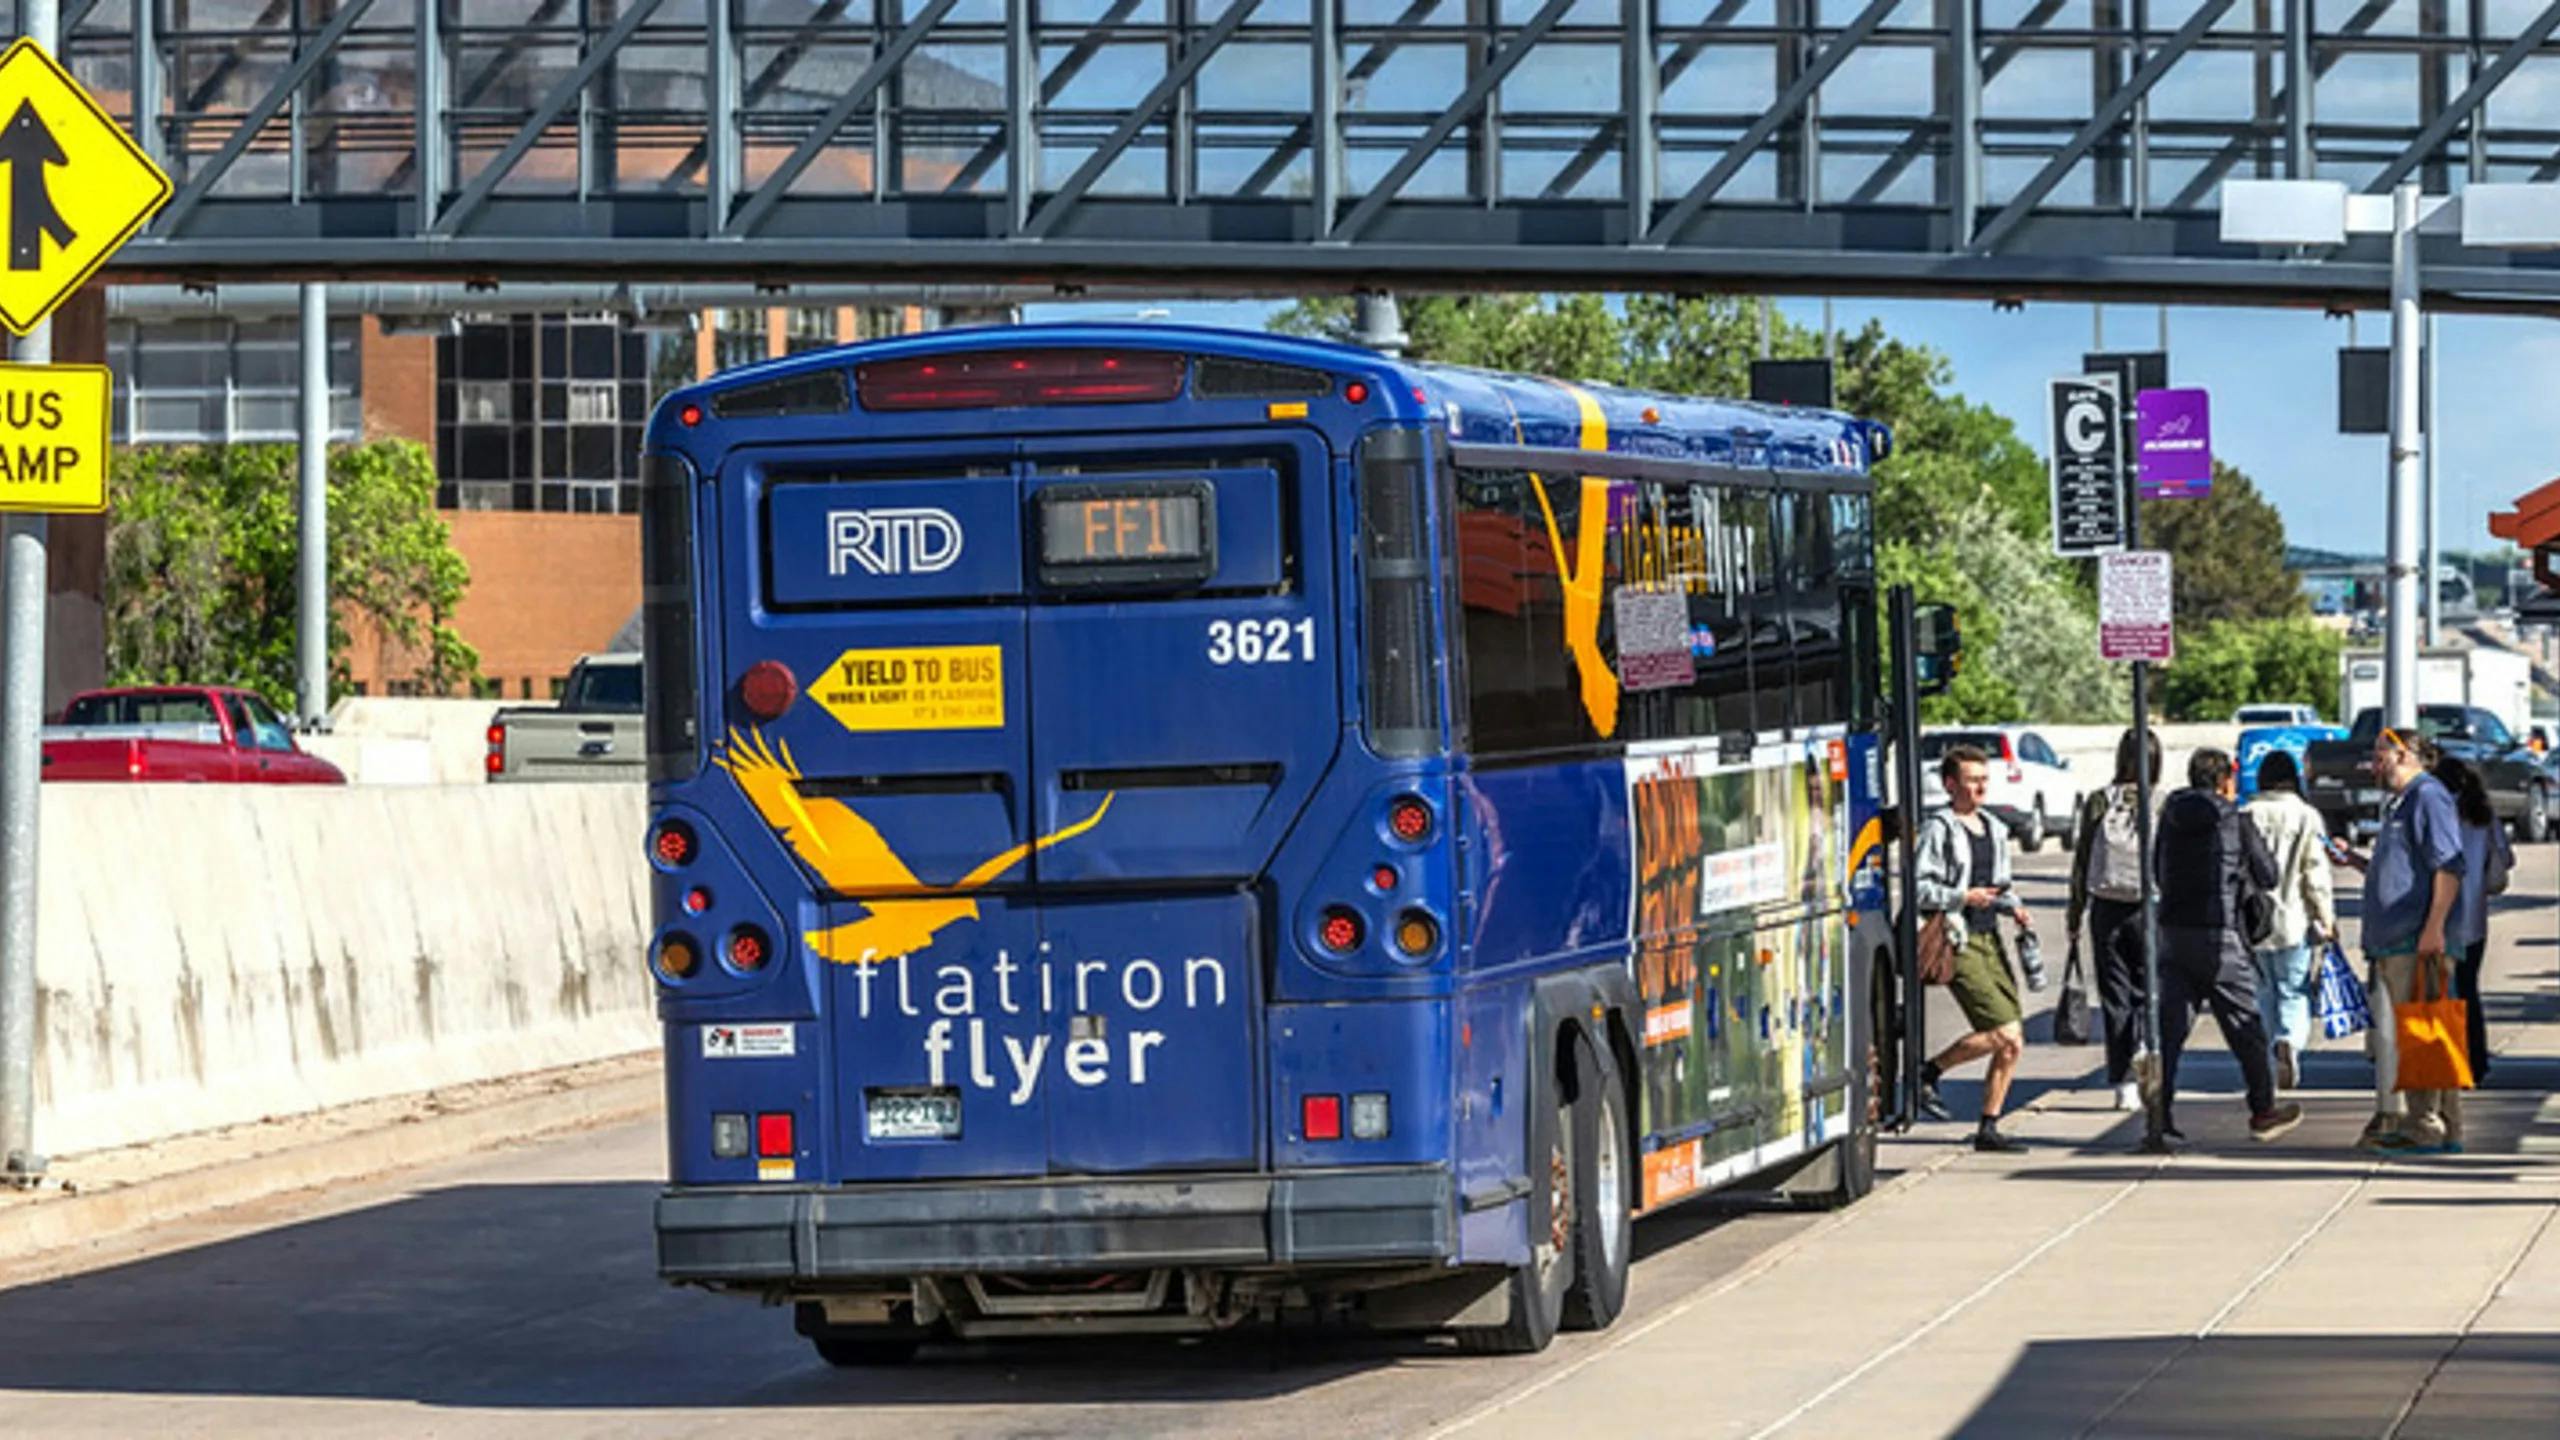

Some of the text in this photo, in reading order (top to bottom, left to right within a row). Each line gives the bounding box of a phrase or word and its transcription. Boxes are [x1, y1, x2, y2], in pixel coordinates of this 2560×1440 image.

[0, 390, 62, 430] US
[2064, 402, 2106, 452] C
[827, 507, 963, 575] RTD
[1083, 499, 1167, 554] FF1
[1207, 617, 1316, 665] 3621
[841, 656, 996, 686] YIELD TO BUS
[826, 692, 866, 705] WHEN
[870, 690, 907, 704] LIGHT
[853, 943, 1228, 1018] flatiron
[924, 1016, 1166, 1106] flyer
